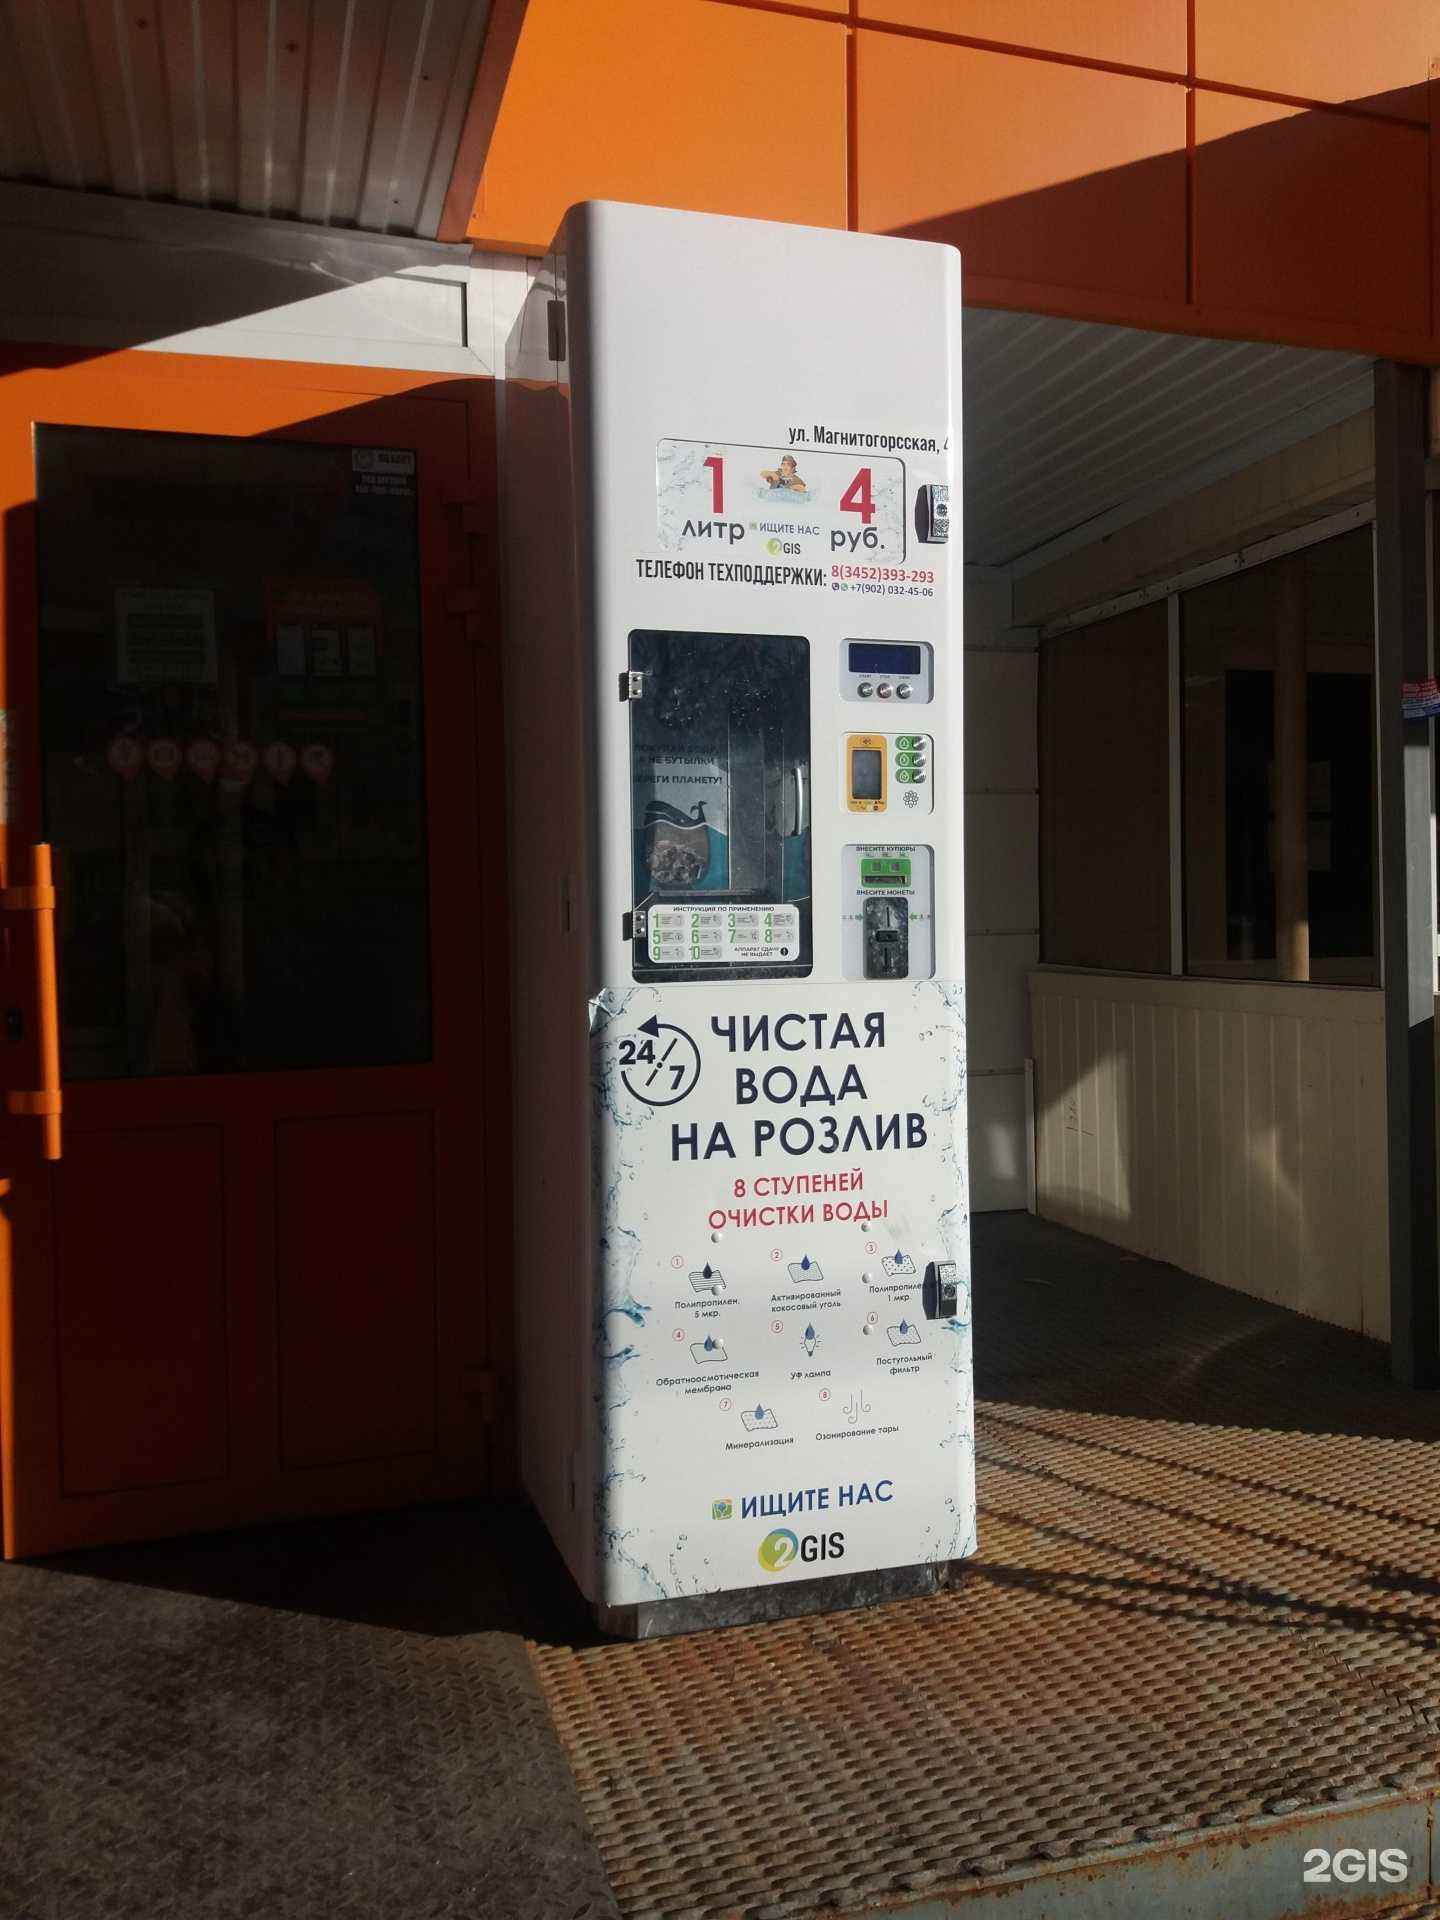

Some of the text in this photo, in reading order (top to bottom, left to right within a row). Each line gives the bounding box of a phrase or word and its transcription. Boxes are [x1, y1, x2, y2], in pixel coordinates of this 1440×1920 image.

[788, 427, 810, 445] ул.
[813, 425, 940, 454] Магнитогорсская,
[702, 456, 724, 514] 1
[839, 467, 876, 525] 4
[681, 519, 745, 545] литр
[759, 523, 821, 536] ИЩИТЕ НАС
[830, 526, 885, 553] руб.
[635, 558, 827, 588] ТЕЛЕФОН ТЕХПОДДЕРЖКИ:
[831, 565, 935, 584] 8(3452)393-293
[851, 583, 934, 597] +7(902) 032-45-06
[672, 775, 722, 785] ПЛАНЕТУ!
[652, 913, 660, 928] 1
[691, 913, 700, 928] 2
[728, 913, 736, 928] 3
[764, 912, 773, 927] 4
[652, 929, 661, 944] 5
[691, 929, 700, 944] 6
[728, 929, 736, 943] 7
[764, 928, 773, 943] 8
[653, 945, 661, 960] 9
[710, 1011, 885, 1053] ЧИСТАЯ
[735, 1063, 868, 1108] ВОДА
[671, 1112, 929, 1162] НА РОЗЛИВ
[733, 1167, 865, 1198] 8 СТУПЕНЕЙ
[708, 1199, 889, 1230] ОЧИСТКИ ВОДЫ
[771, 1289, 842, 1302] Активированный
[869, 1283, 923, 1294] Полипропиле
[674, 1298, 740, 1309] Полипропилен.
[771, 1301, 841, 1313] кокосовый уголь
[701, 1310, 721, 1319] мкр.
[876, 1353, 933, 1367] Постугольный
[790, 1369, 832, 1380] УФ лампа
[889, 1365, 920, 1376] фильтр
[656, 1370, 760, 1387] Обратноосмотическая
[684, 1384, 732, 1395] мембрана
[815, 1425, 900, 1442] Озонирование тары
[725, 1436, 794, 1451] Минерализация
[740, 1479, 894, 1520] ИЩИТЕ НАС
